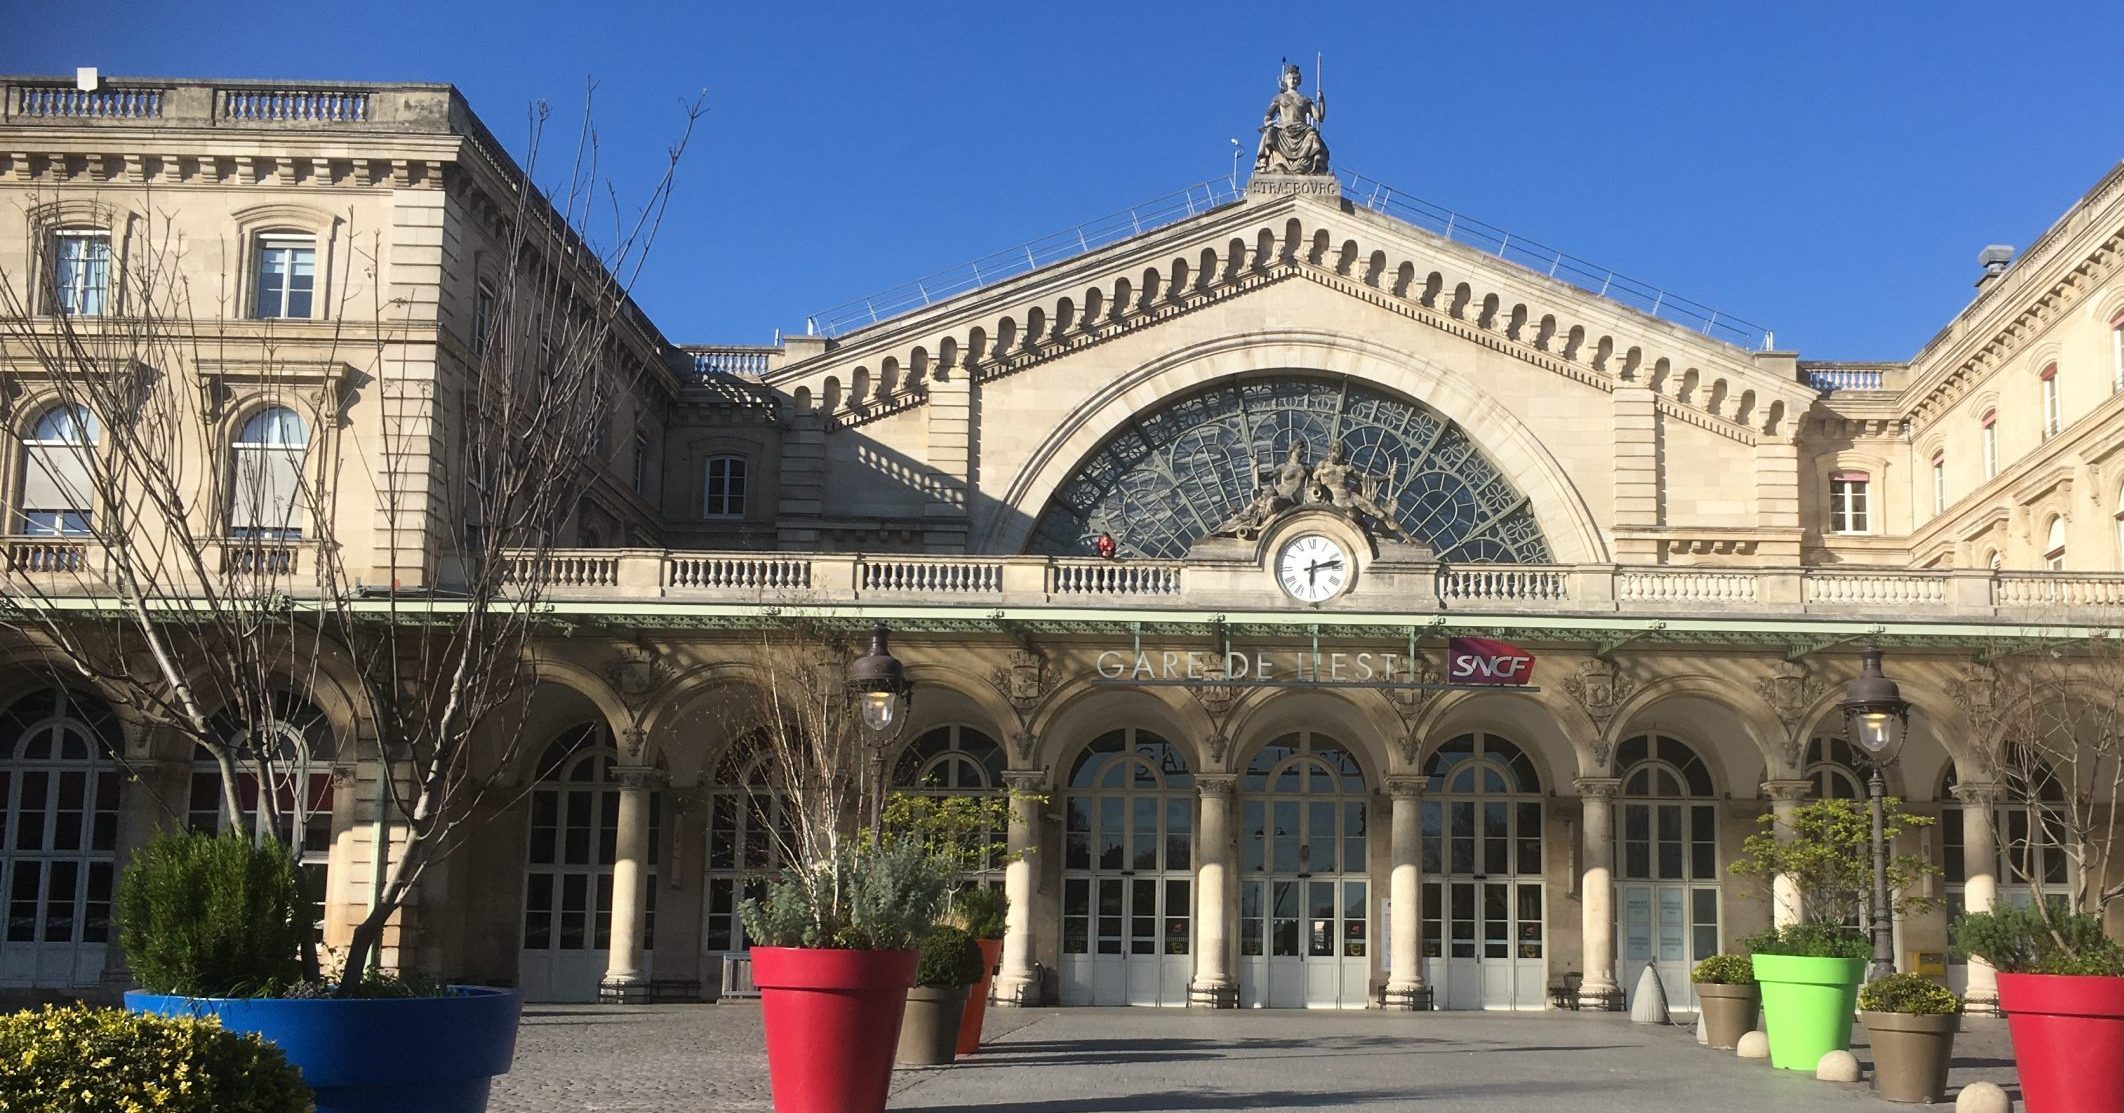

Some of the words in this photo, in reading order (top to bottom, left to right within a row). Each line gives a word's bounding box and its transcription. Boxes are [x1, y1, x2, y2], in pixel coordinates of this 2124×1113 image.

[1097, 651, 1202, 679] GARE
[1227, 652, 1272, 679] DE
[1453, 655, 1530, 677] SNCF
